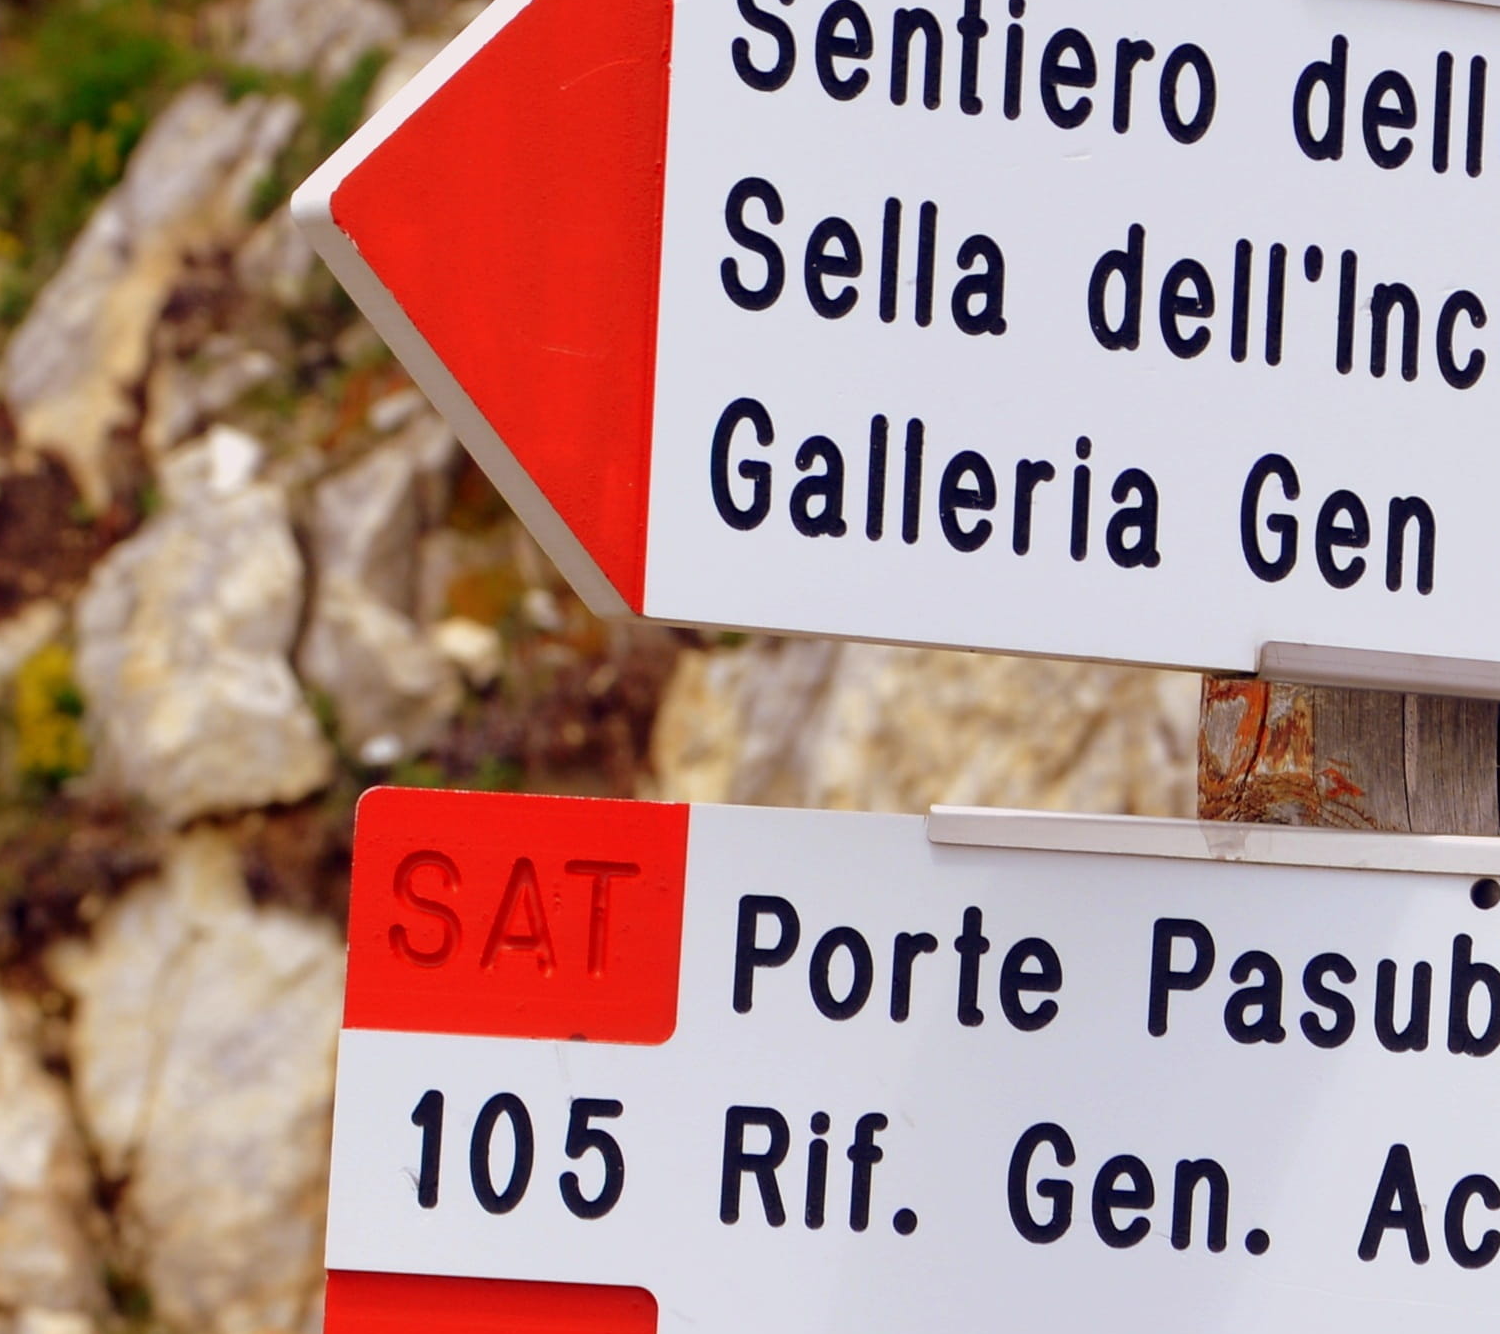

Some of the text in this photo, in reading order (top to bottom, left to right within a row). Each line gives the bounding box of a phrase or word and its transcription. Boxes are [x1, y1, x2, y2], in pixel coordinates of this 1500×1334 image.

[719, 175, 1008, 337] Sella
[709, 396, 1162, 570] Galleria
[1239, 452, 1437, 597] Gen
[387, 849, 642, 978] SAT
[731, 893, 1064, 1033] Porte
[410, 1088, 626, 1221] 105
[718, 1104, 919, 1237] Rif.
[1006, 1121, 1271, 1257] Gen.
